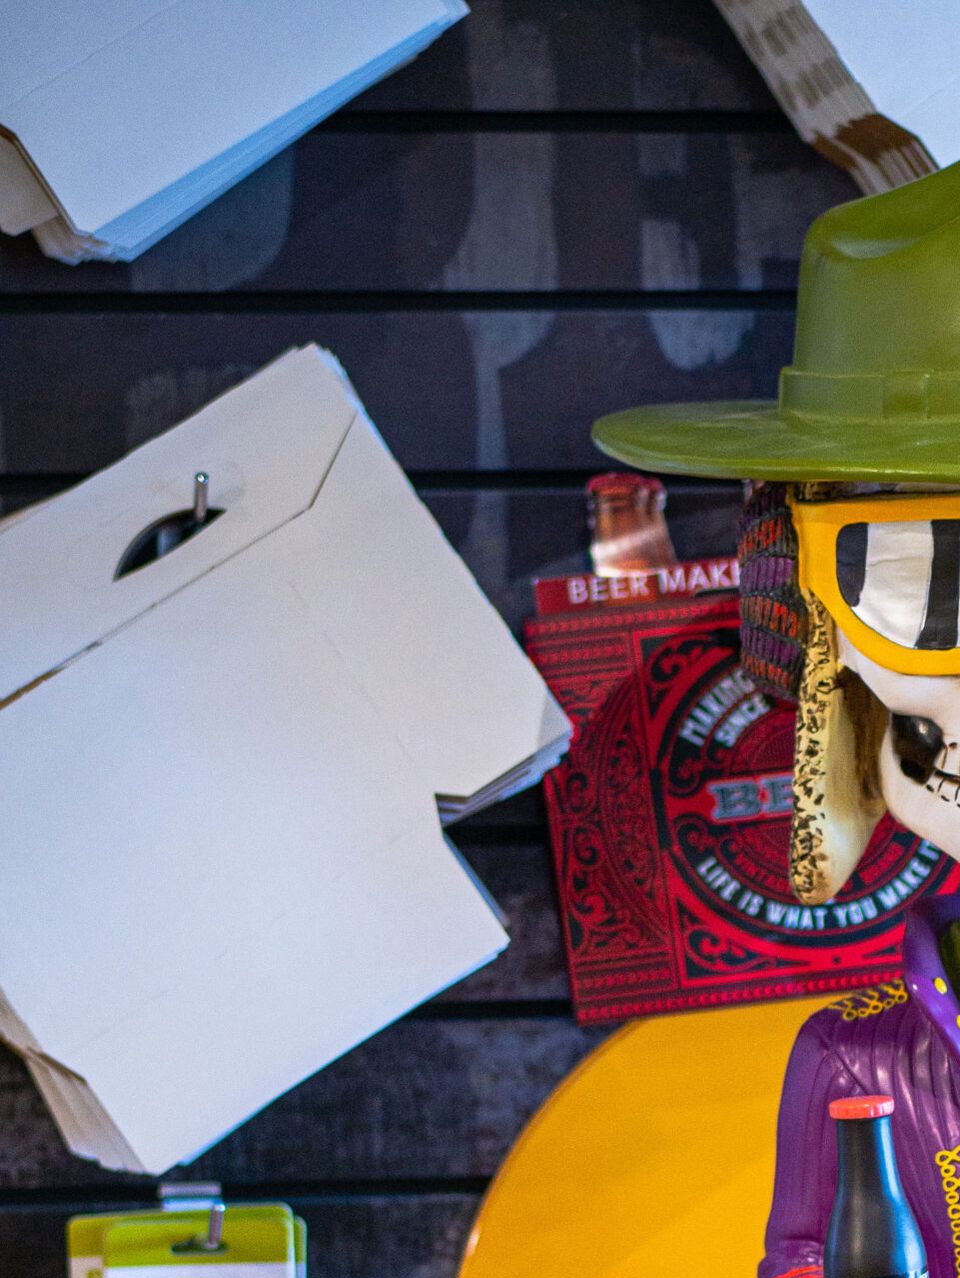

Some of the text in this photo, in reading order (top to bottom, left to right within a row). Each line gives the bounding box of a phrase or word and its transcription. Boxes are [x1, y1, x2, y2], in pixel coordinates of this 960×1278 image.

[568, 572, 650, 604] BEER
[715, 690, 771, 748] SINCE
[696, 855, 741, 901] LIFE
[737, 891, 764, 917] IS
[765, 900, 828, 930] WHAT
[833, 897, 878, 928] YOU
[877, 857, 932, 910] MAKE
